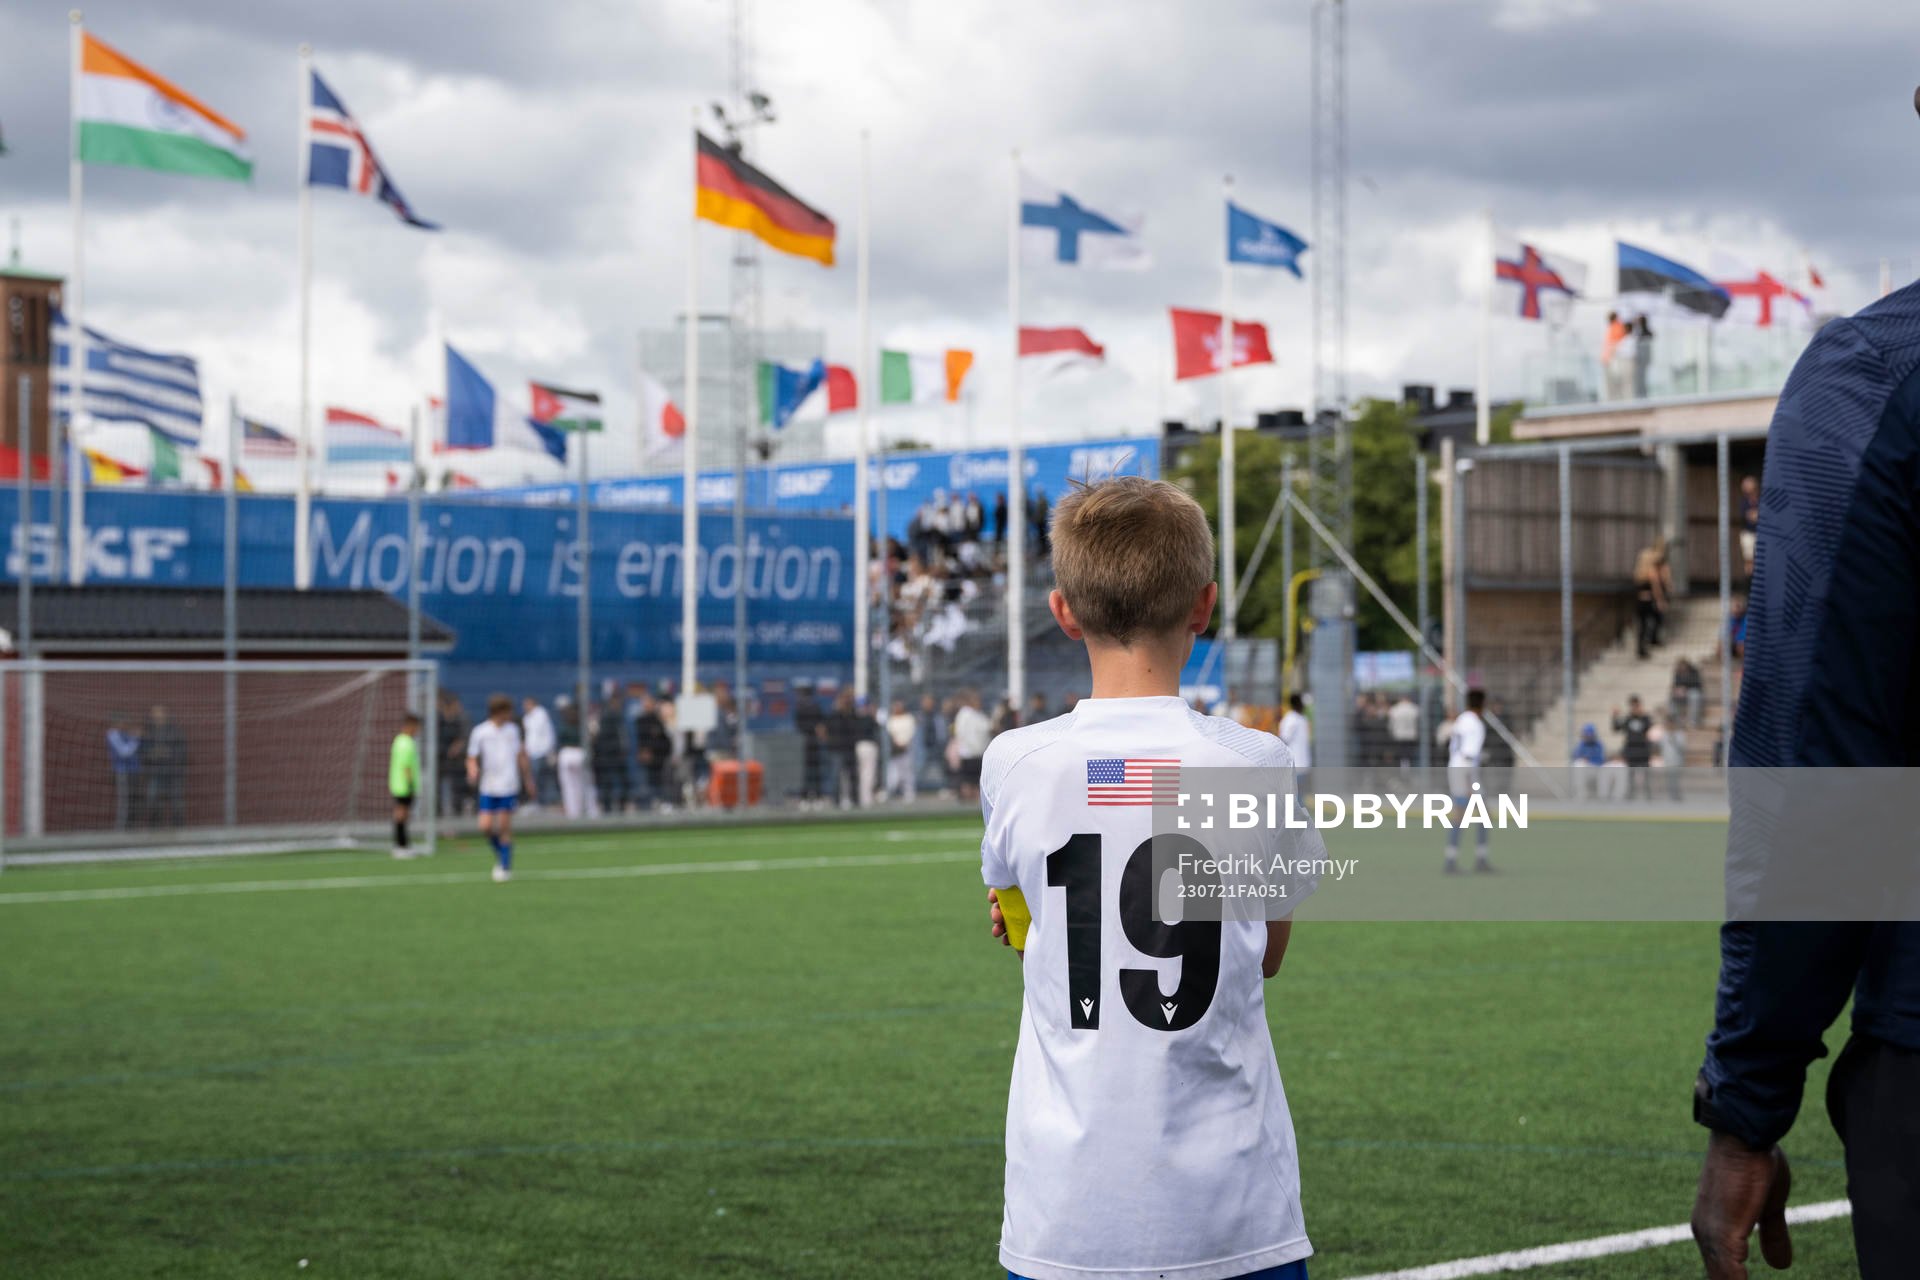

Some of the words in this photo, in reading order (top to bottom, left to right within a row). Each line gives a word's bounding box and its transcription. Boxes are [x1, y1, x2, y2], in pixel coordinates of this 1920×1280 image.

[6, 522, 190, 578] SKF
[310, 509, 525, 595] Motion
[547, 516, 592, 597] is
[615, 524, 842, 600] emotion
[1046, 832, 1222, 1032] 19
